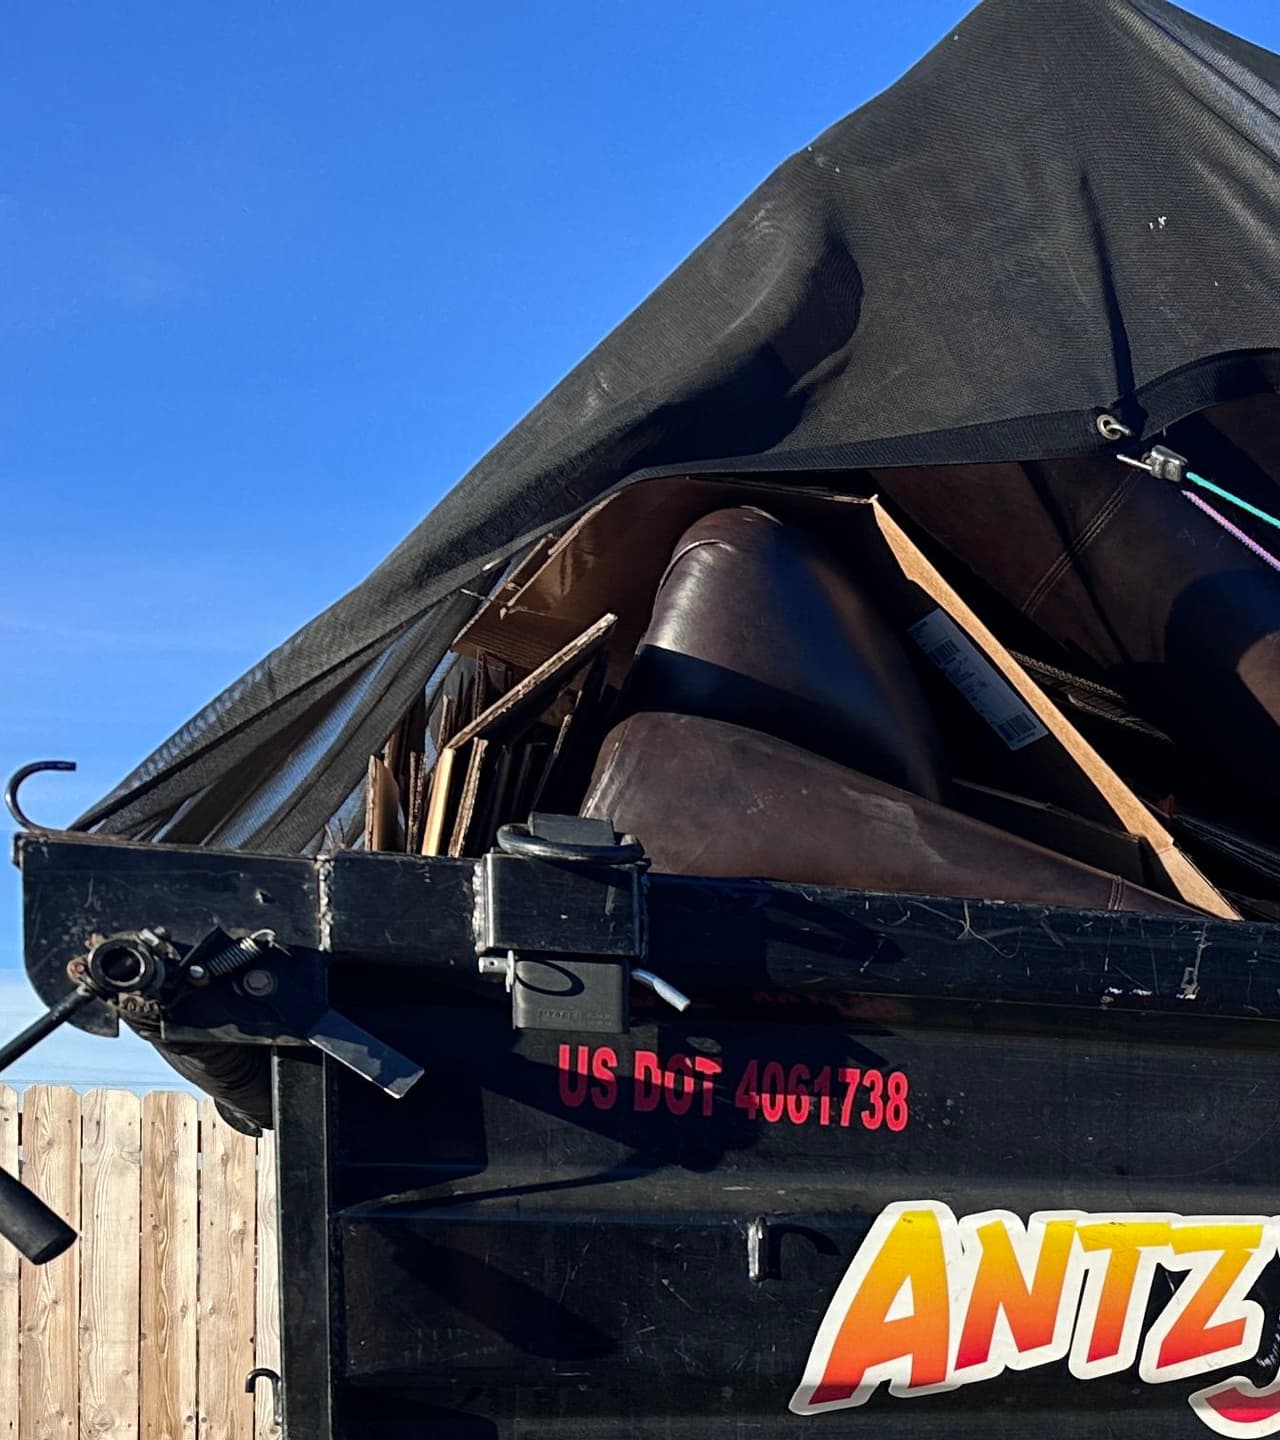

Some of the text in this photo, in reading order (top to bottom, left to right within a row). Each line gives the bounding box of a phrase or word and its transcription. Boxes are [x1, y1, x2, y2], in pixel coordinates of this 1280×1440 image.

[557, 1043, 910, 1133] US DOT 4061738
